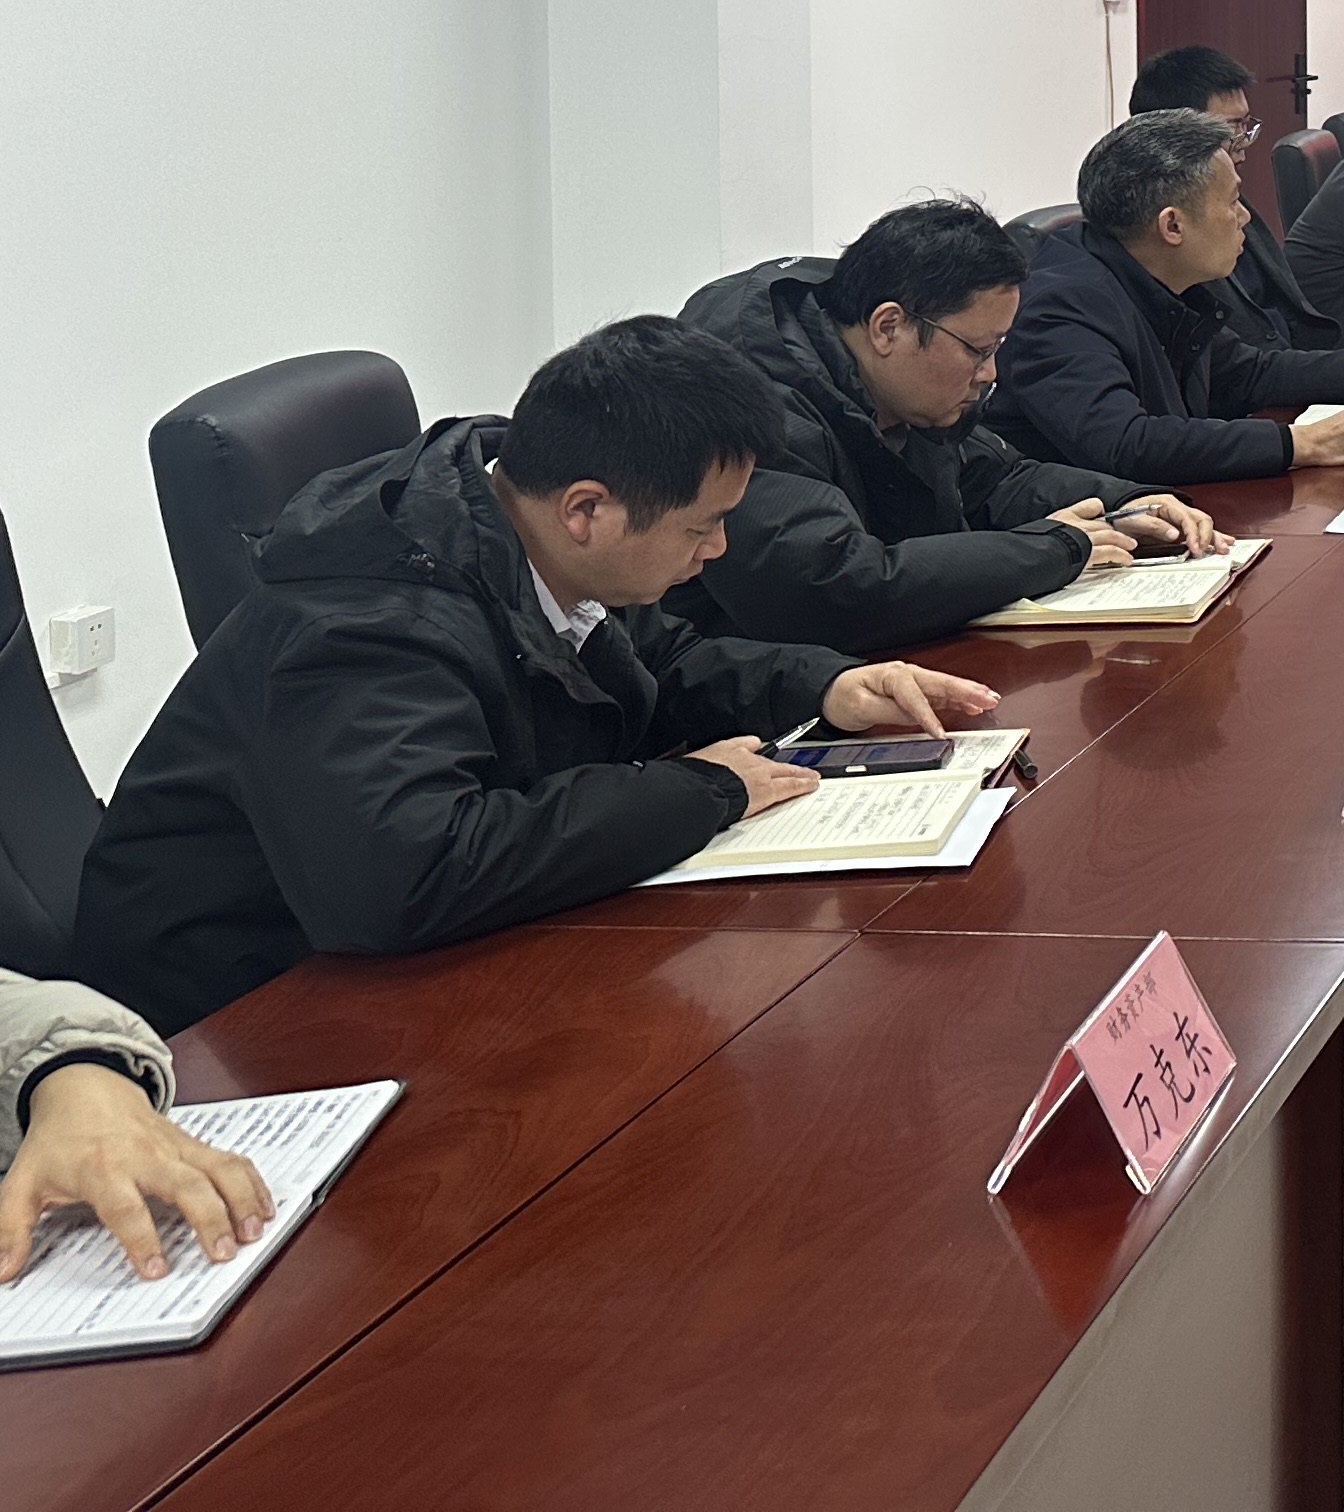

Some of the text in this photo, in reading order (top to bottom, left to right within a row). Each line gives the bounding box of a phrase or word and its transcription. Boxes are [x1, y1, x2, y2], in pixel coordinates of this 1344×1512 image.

[1105, 972, 1158, 1044] 财务资产部
[1123, 1011, 1213, 1152] 万克东
